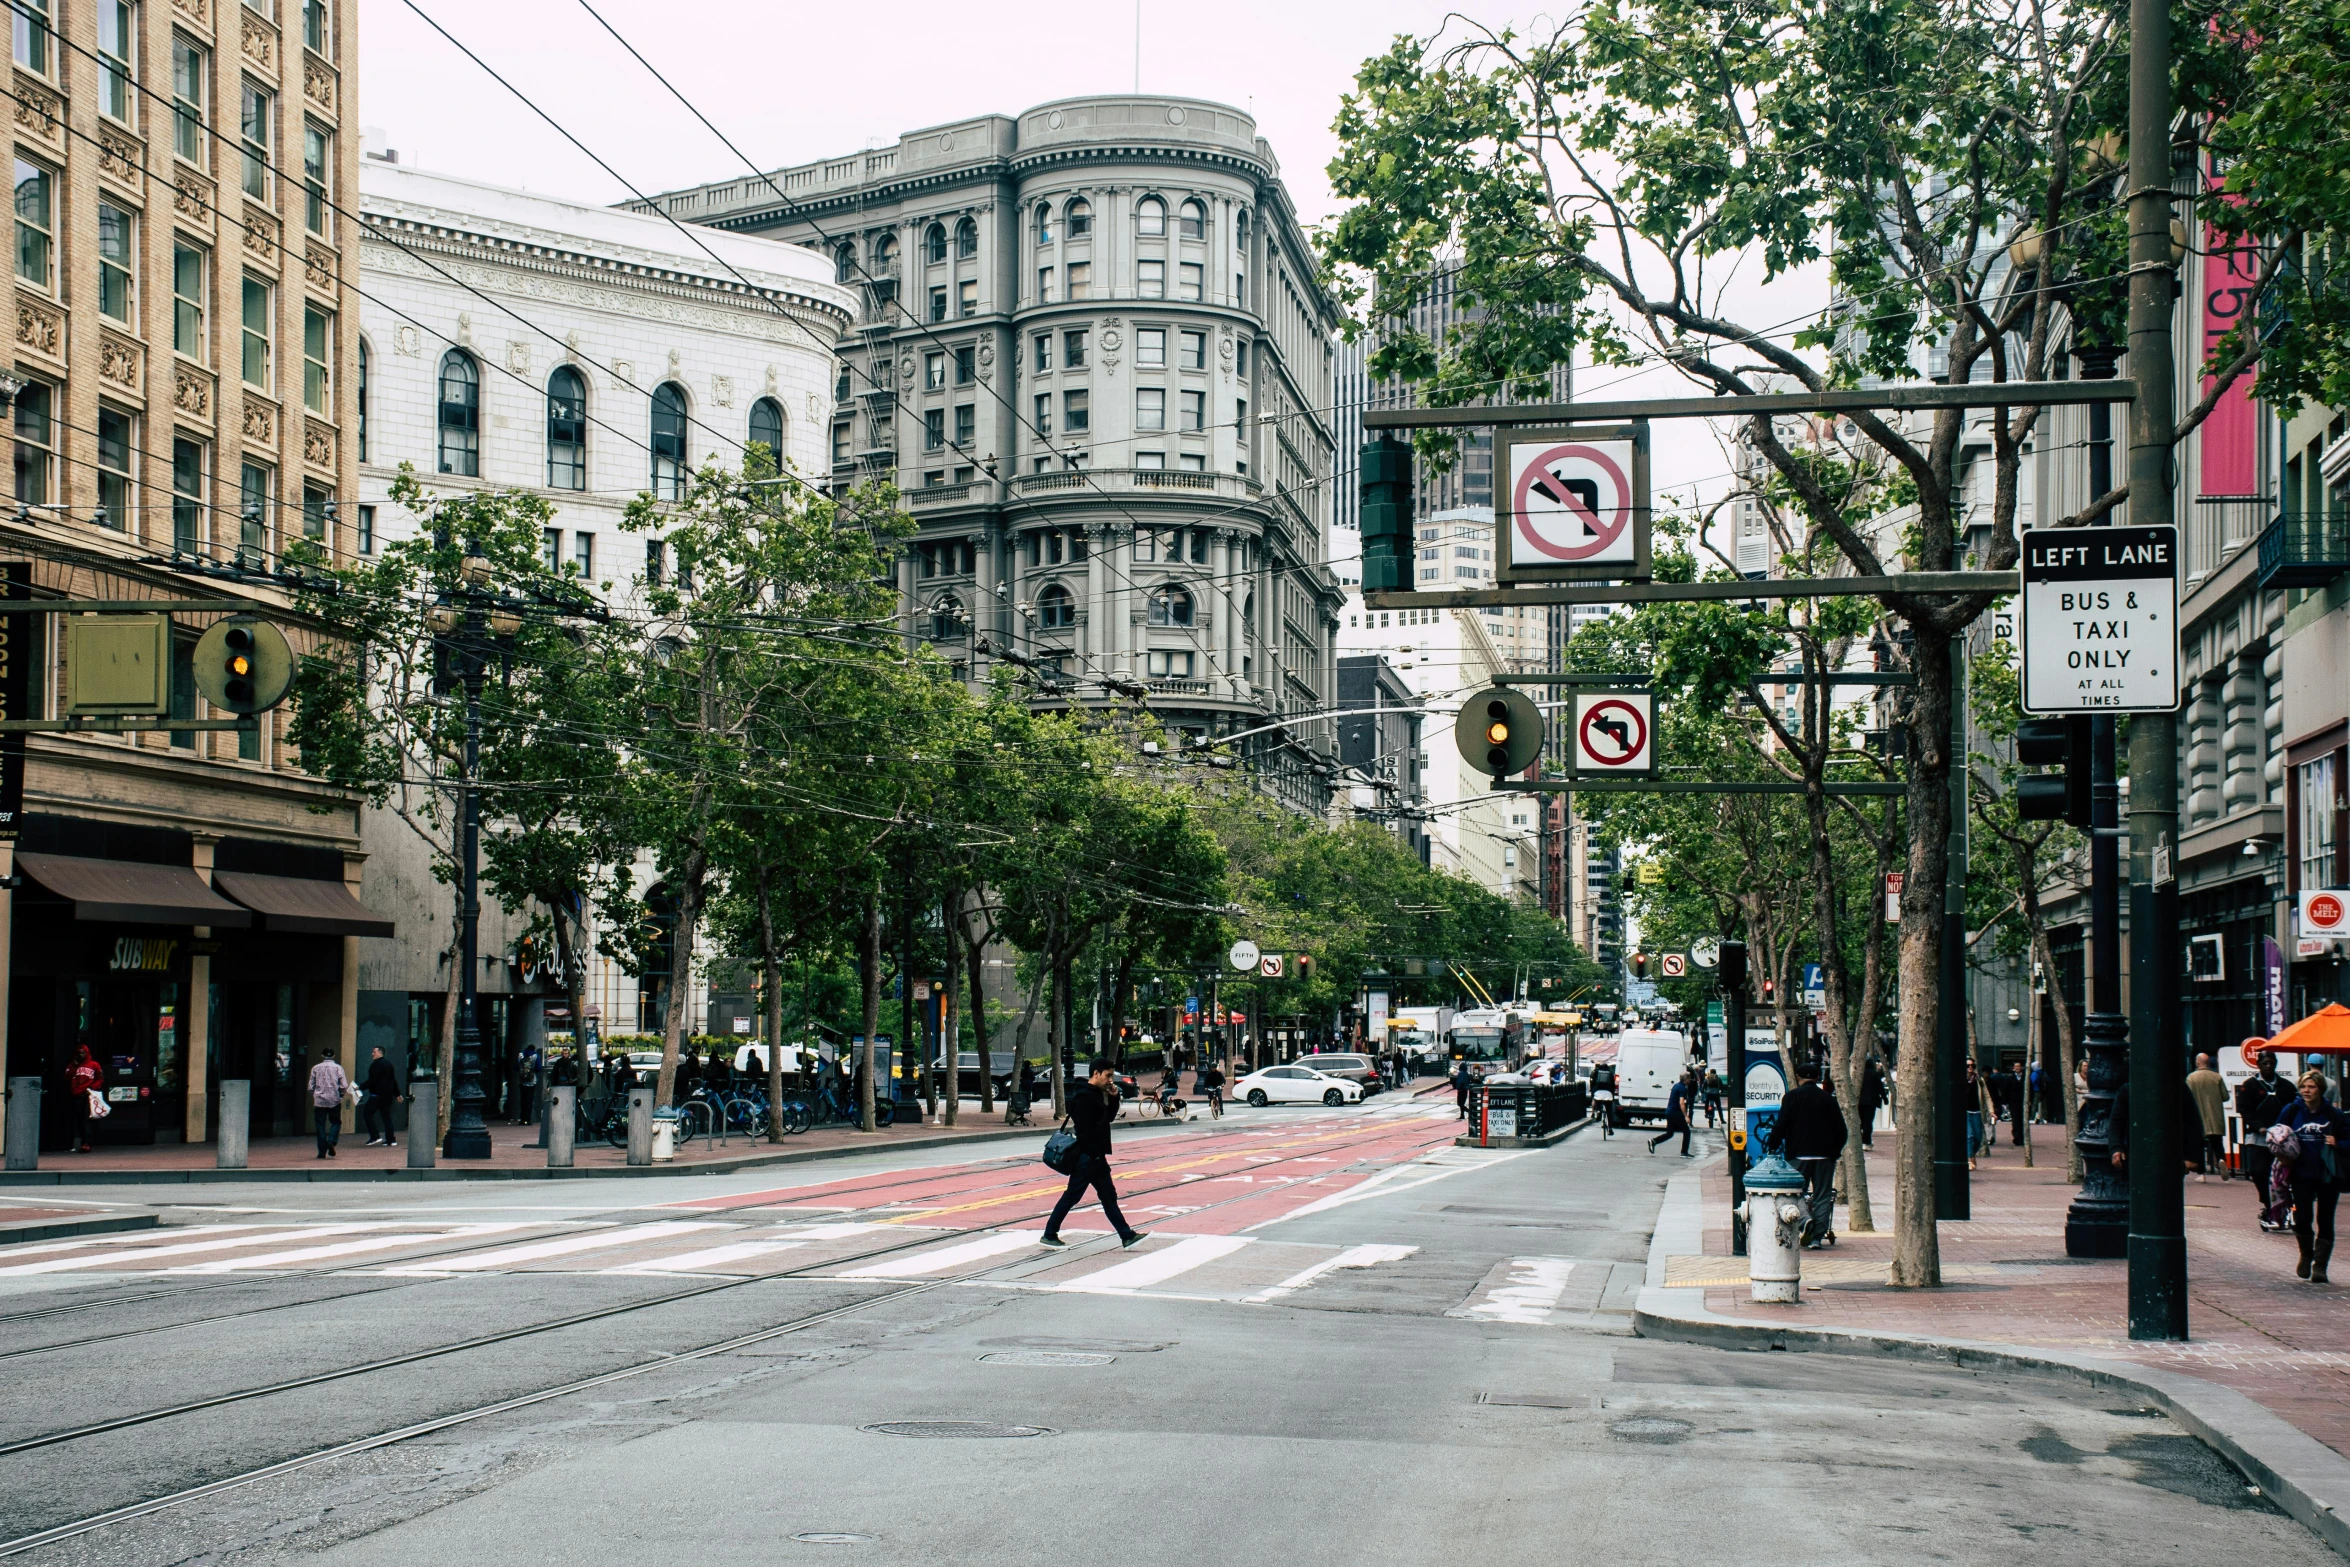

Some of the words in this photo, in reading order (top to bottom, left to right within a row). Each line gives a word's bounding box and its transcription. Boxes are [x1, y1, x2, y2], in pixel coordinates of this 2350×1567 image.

[2032, 547, 2089, 567] LEFT
[2104, 544, 2168, 565] LANE
[2061, 592, 2110, 611] BUS
[2126, 591, 2138, 610] &
[2073, 620, 2129, 640] TAXI
[2067, 649, 2131, 669] ONLY
[2078, 680, 2092, 689] AT
[2100, 679, 2125, 689] ALL
[2081, 696, 2120, 706] TIMES
[2317, 903, 2334, 911] THE
[2312, 909, 2339, 918] MELT
[109, 937, 178, 970] SUBWAY
[2271, 966, 2284, 1037] metr
[1754, 1037, 1778, 1045] SailPoin
[1748, 1081, 1772, 1091] Identity
[1773, 1081, 1779, 1089] is
[1745, 1092, 1782, 1100] SECURITY
